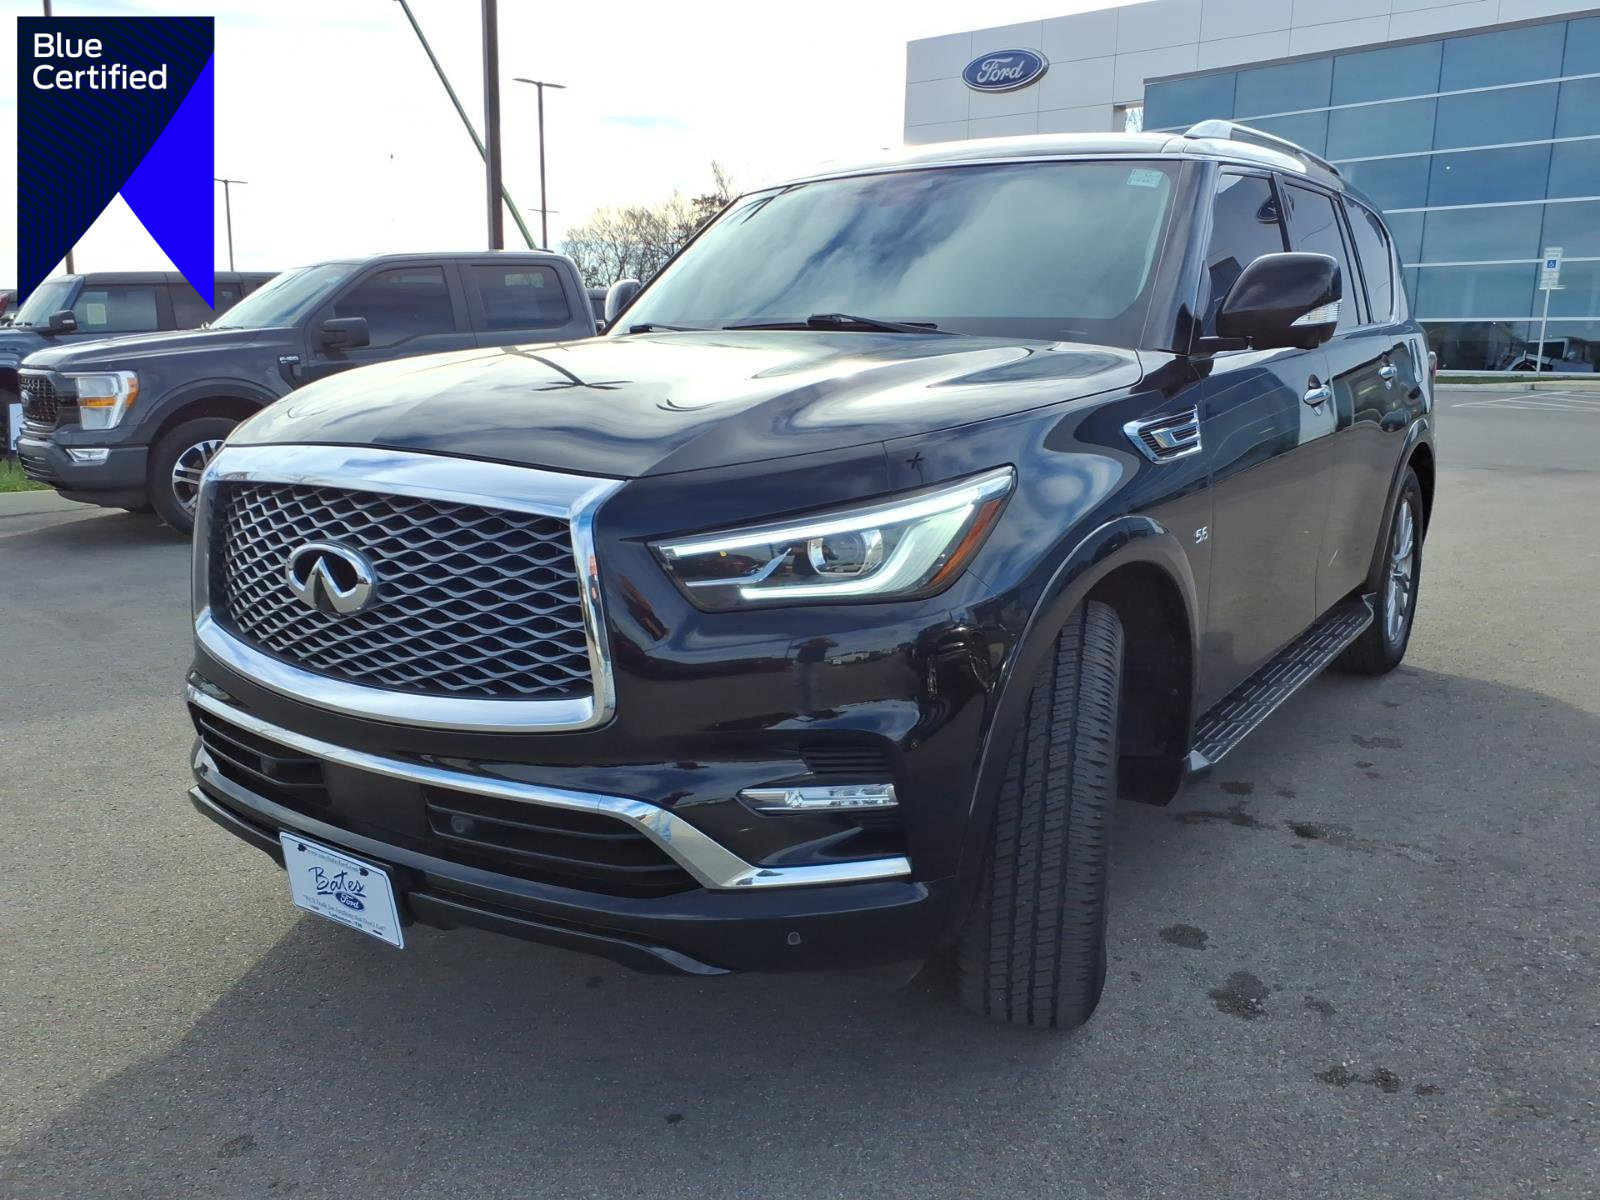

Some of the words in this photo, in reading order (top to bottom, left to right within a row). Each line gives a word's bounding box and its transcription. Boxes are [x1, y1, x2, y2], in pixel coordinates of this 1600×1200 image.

[977, 57, 1025, 83] Ford
[308, 866, 365, 892] Bates
[340, 893, 360, 909] Ford
